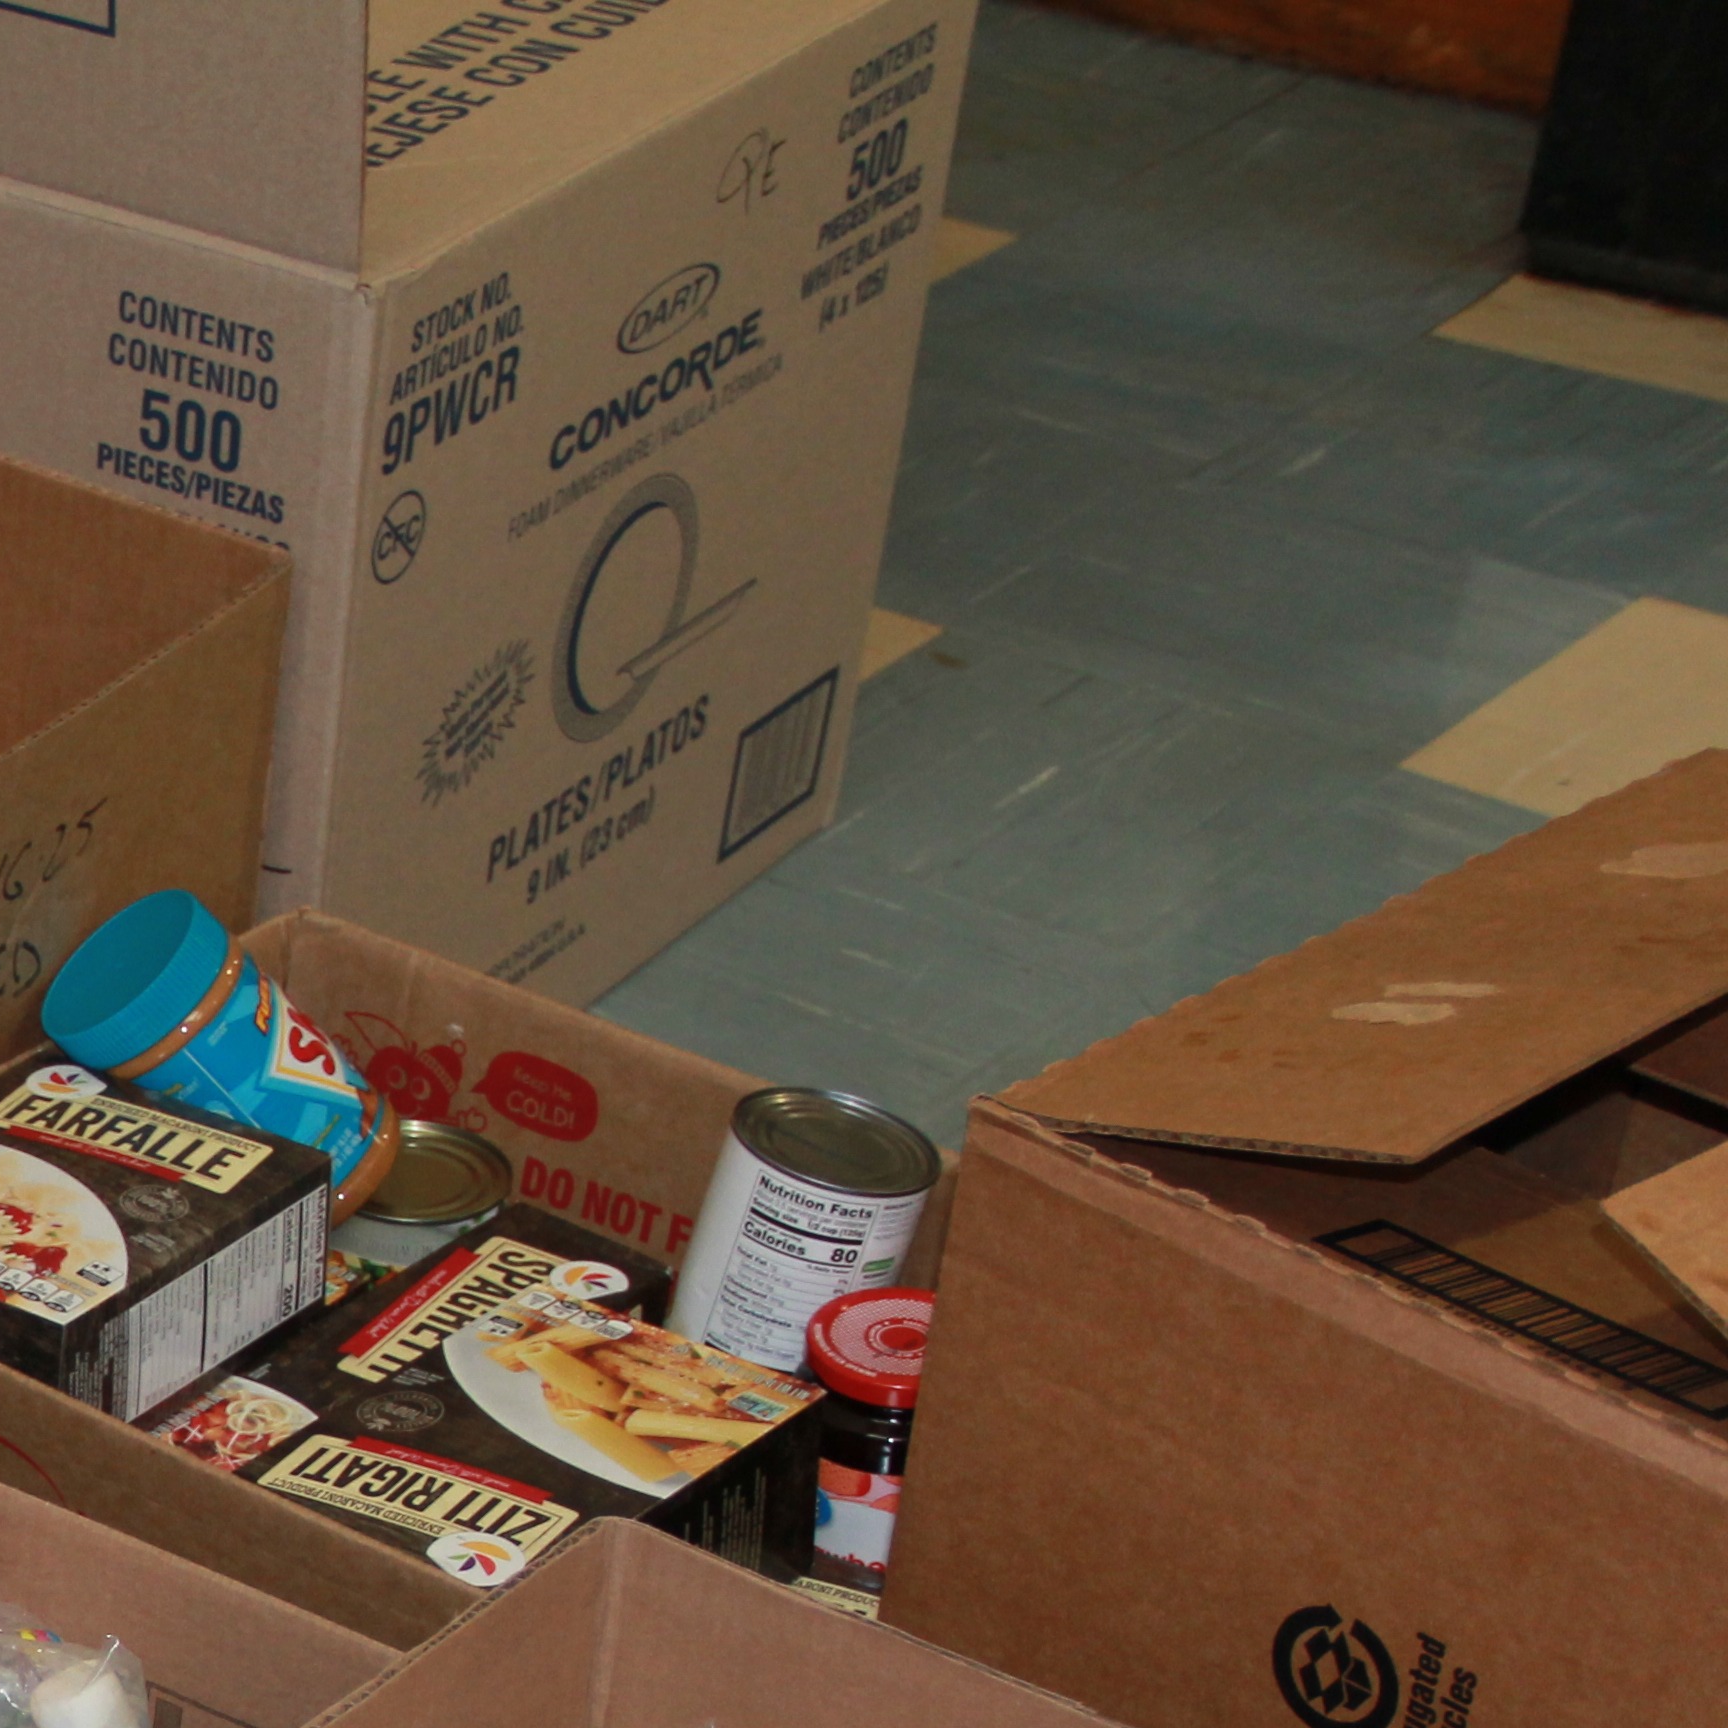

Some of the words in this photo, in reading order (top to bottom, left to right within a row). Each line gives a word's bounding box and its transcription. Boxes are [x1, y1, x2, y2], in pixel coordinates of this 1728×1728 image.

[392, 12, 531, 70] WITH
[464, 38, 580, 87] CON
[847, 117, 907, 201] 500
[119, 290, 275, 363] CONTENTS
[411, 297, 477, 353] STOCK
[480, 271, 512, 311] NO.
[493, 304, 524, 341] NO.
[630, 273, 709, 344] DART
[108, 332, 279, 411] CONTENIDO
[549, 308, 764, 470] CONCORDE
[139, 388, 242, 472] 500
[382, 345, 521, 476] 9PWCR
[96, 442, 285, 524] PIECES/PIEZAS
[377, 514, 421, 561] CFC
[487, 695, 710, 882] PLATES/PLATOS
[527, 869, 540, 904] 9
[4, 1092, 247, 1182] FARFALLE
[505, 1089, 576, 1131] COLD!
[519, 1155, 575, 1211] DO
[580, 1180, 664, 1244] NOT
[758, 1175, 825, 1212] Nutrition
[829, 1203, 874, 1220] Facts
[743, 1220, 807, 1257] Calories
[829, 1246, 859, 1264] 80
[290, 1445, 456, 1512] RIGATI
[441, 1489, 553, 1546] ZITI
